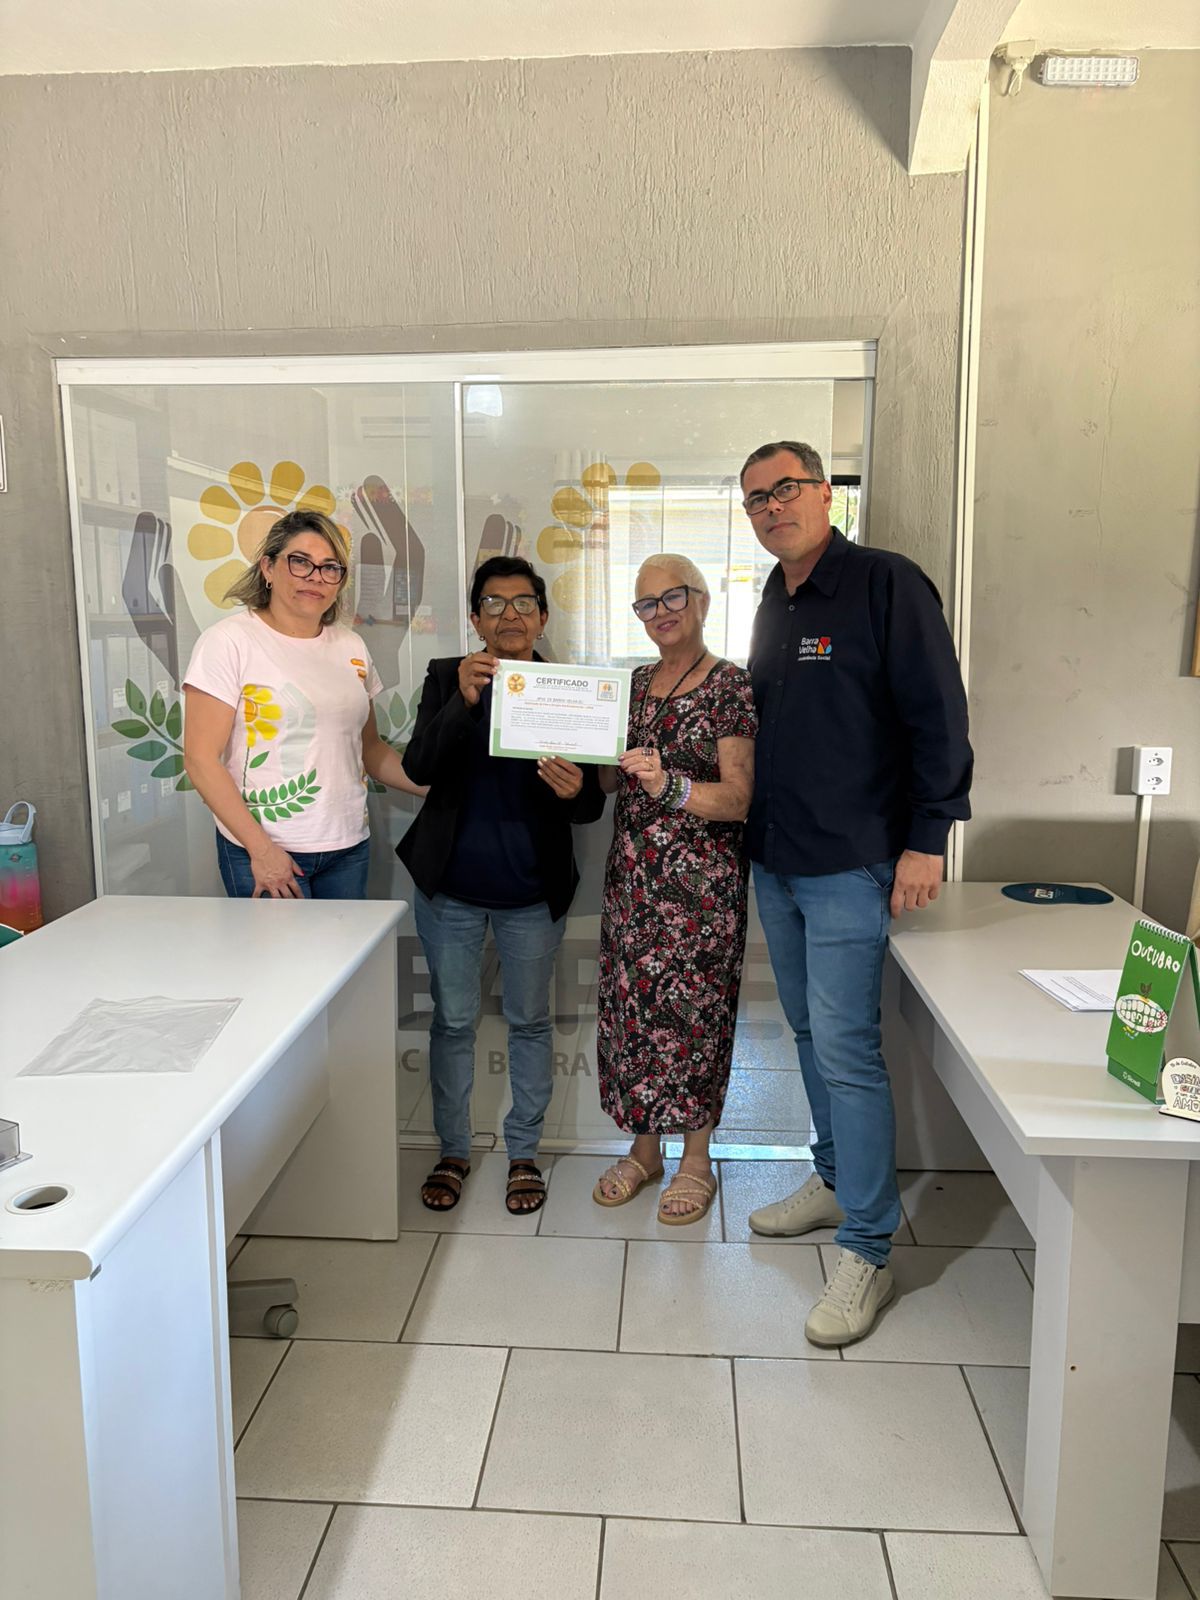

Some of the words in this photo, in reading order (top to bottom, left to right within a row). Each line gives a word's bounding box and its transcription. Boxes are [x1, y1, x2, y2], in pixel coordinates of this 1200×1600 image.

[801, 637, 819, 646] Barra
[799, 645, 817, 654] Velha
[536, 677, 589, 688] CERTIFICADO
